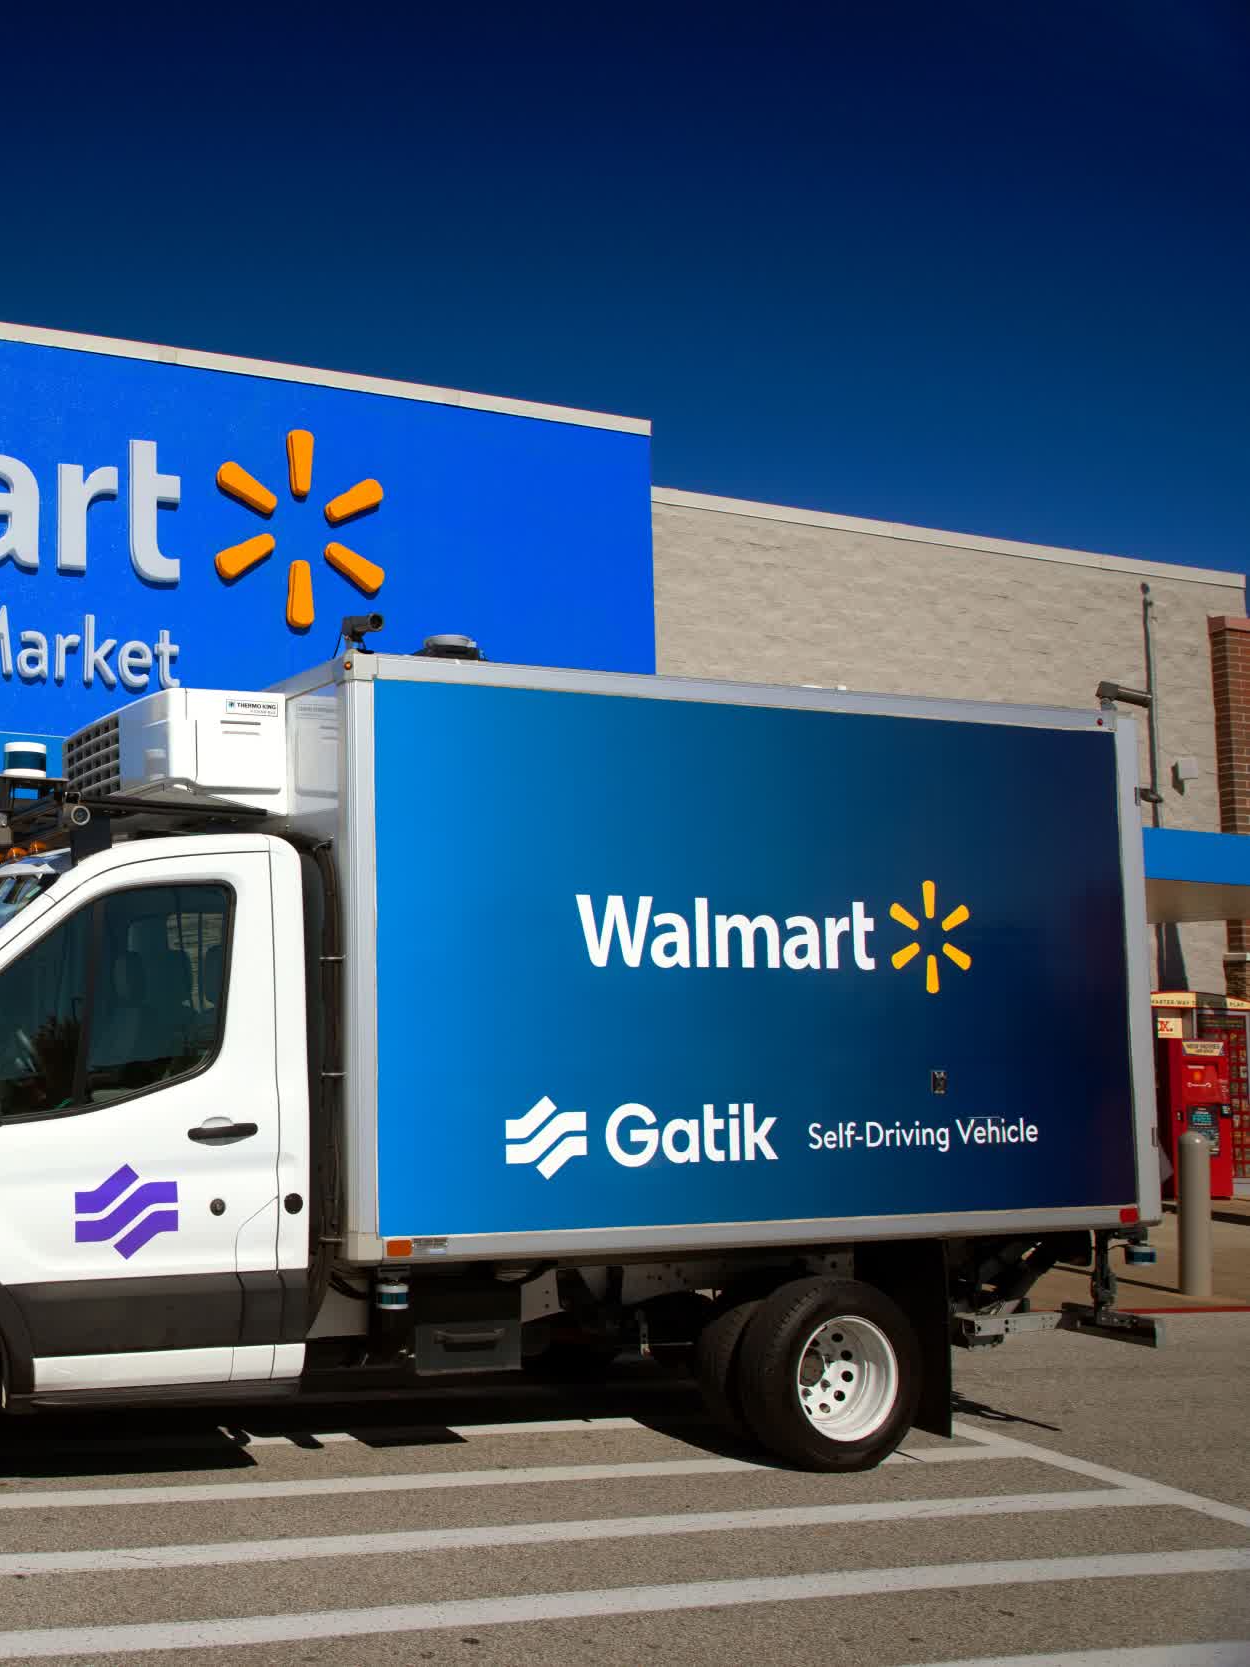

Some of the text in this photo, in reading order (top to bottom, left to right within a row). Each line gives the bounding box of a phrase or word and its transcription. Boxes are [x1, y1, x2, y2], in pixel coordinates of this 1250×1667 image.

[575, 894, 876, 971] Walmart
[605, 1103, 1039, 1168] Gatik Self-Driving Vehicle
